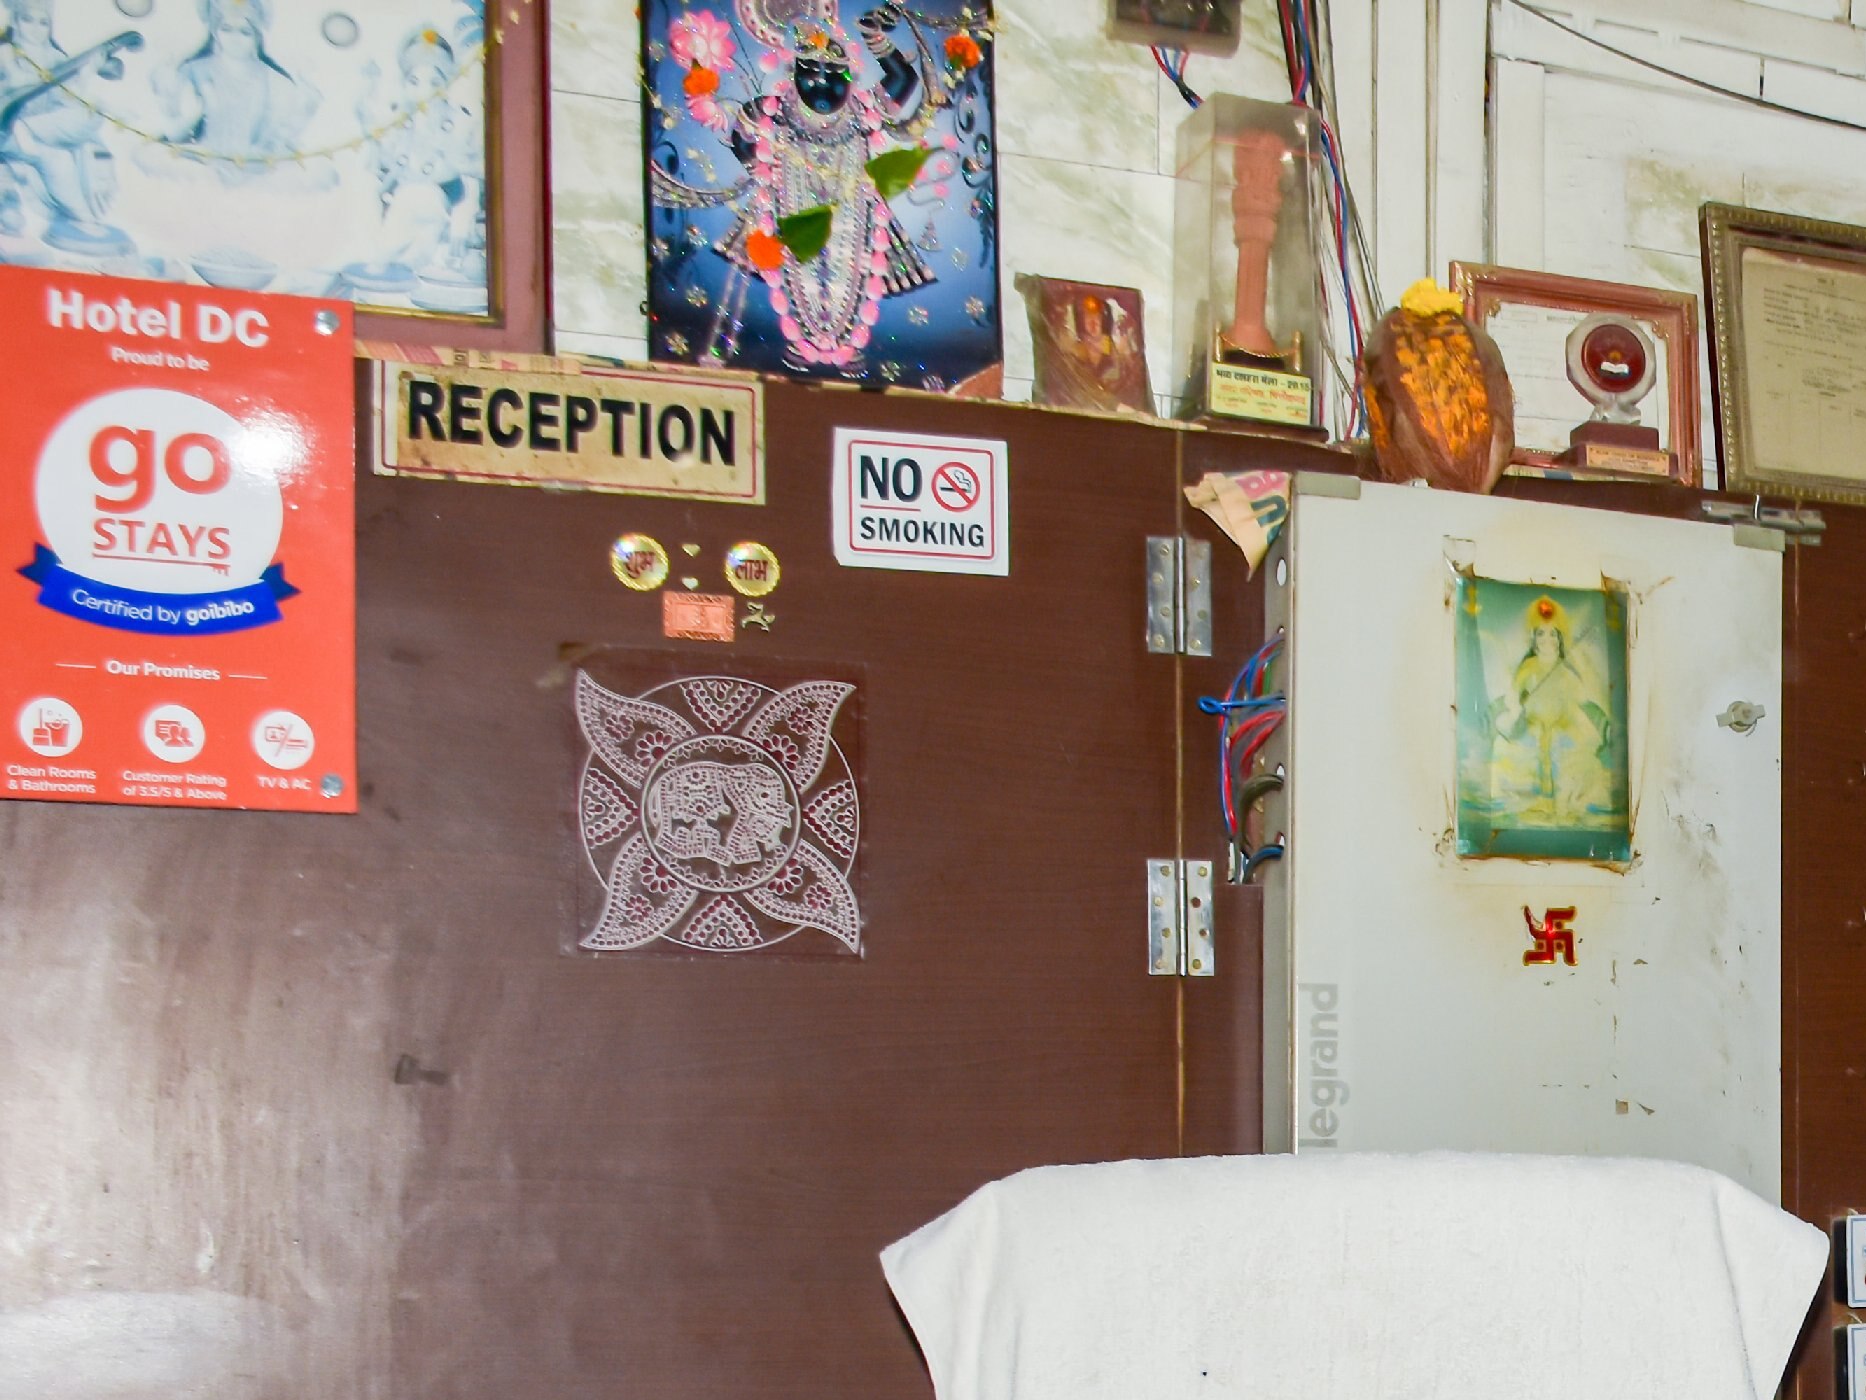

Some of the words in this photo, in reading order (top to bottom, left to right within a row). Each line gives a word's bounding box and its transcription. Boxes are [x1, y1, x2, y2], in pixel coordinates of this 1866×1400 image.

[47, 288, 181, 340] Hotel
[197, 304, 270, 348] DC
[110, 346, 164, 367] Proud
[167, 354, 185, 368] to
[187, 355, 210, 371] be
[408, 380, 736, 467] RECEPTION
[88, 425, 231, 515] go
[860, 455, 922, 502] NO
[92, 517, 231, 560] STAYS
[860, 516, 984, 548] SMOKING
[735, 559, 768, 581] लाभ
[73, 589, 152, 621] Certified
[158, 606, 181, 625] by
[186, 601, 255, 626] goibibo
[106, 660, 140, 676] Our
[144, 662, 221, 681] Promises
[6, 765, 46, 778] Clean
[48, 766, 97, 780] Rooms
[122, 771, 183, 784] Customer
[186, 773, 228, 788] Rating
[258, 776, 277, 789] TV
[292, 779, 312, 791] AC
[8, 780, 18, 790] &
[22, 780, 97, 794] Bathrooms
[123, 785, 136, 796] of
[187, 788, 228, 801] Above
[1298, 983, 1351, 1148] legrand
